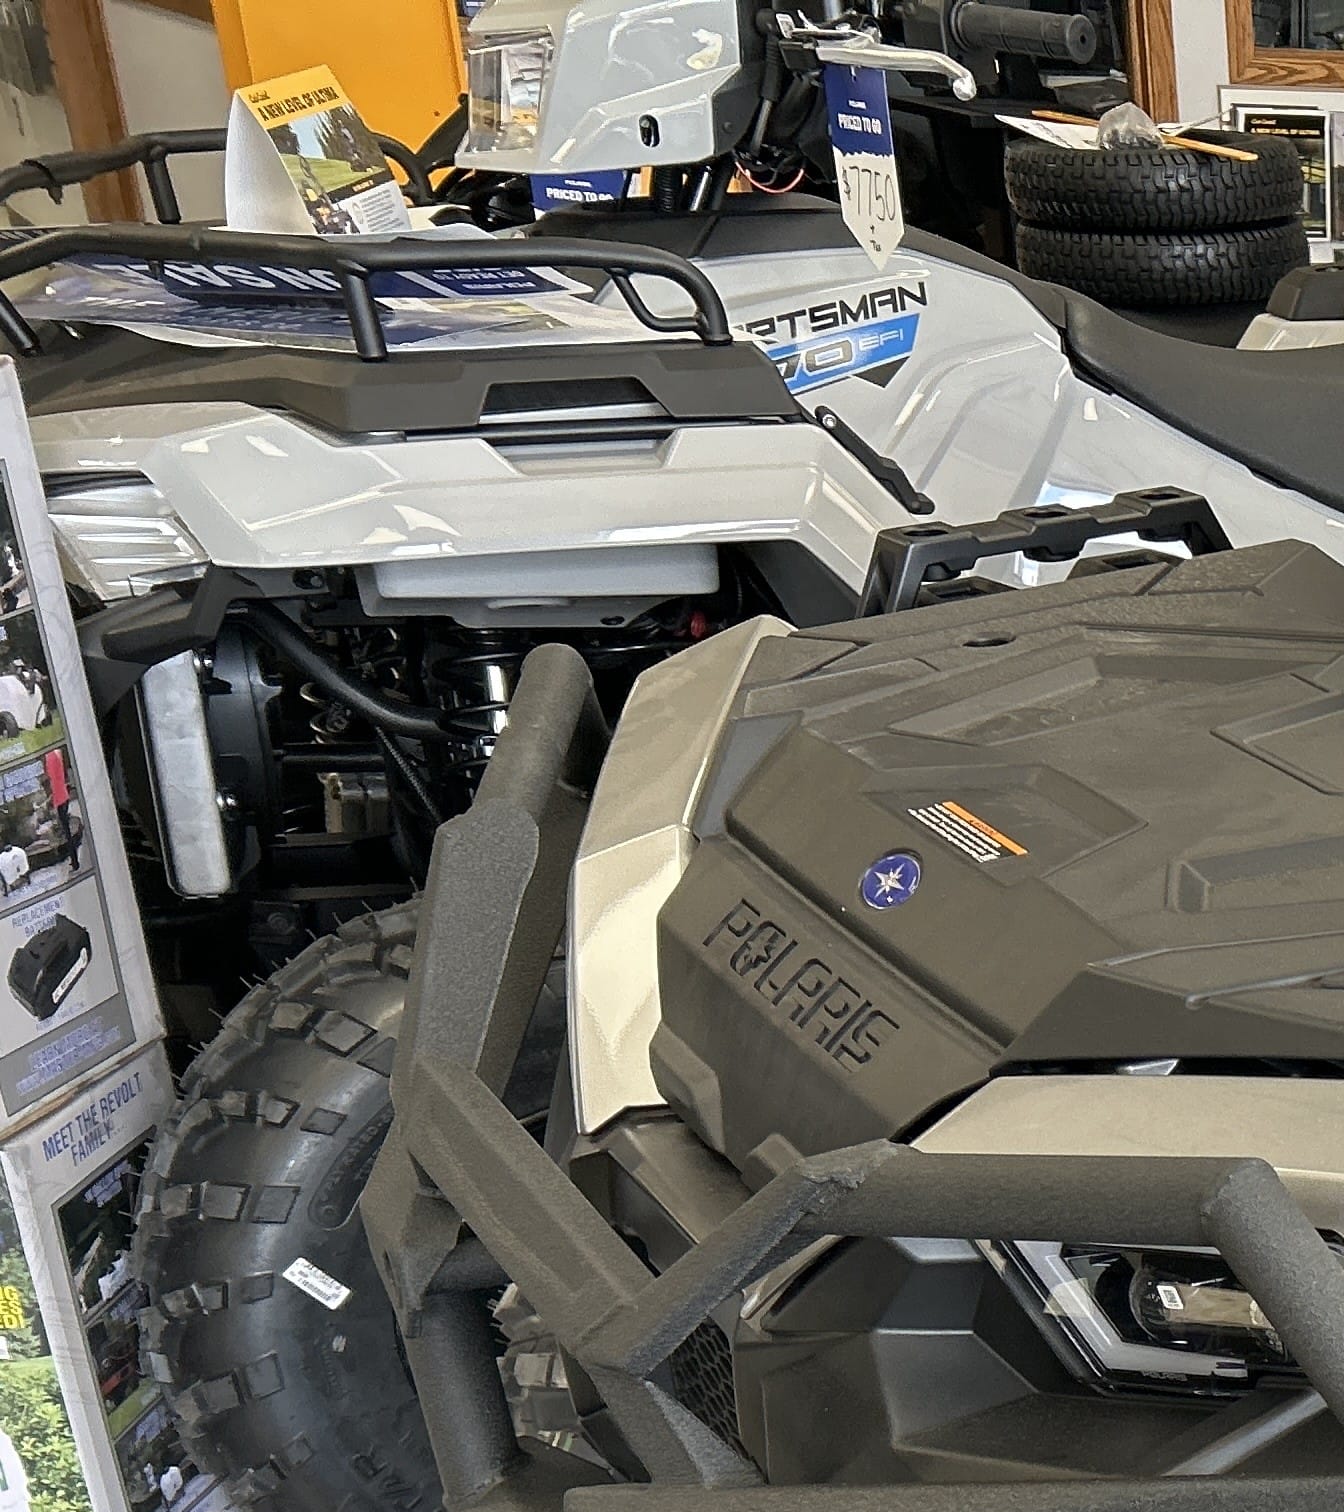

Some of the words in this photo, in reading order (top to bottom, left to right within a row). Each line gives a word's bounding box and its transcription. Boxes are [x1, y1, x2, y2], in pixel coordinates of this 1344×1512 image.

[266, 102, 286, 120] NEW
[280, 95, 306, 115] LEVEL
[545, 187, 583, 202] PRICED
[584, 191, 597, 202] TO
[841, 165, 896, 222] $7750
[858, 328, 904, 352] EFI
[702, 898, 901, 1073] POLARIS
[41, 1128, 76, 1162] MEET
[75, 1106, 100, 1134] THE
[99, 1072, 143, 1120] REVOLT
